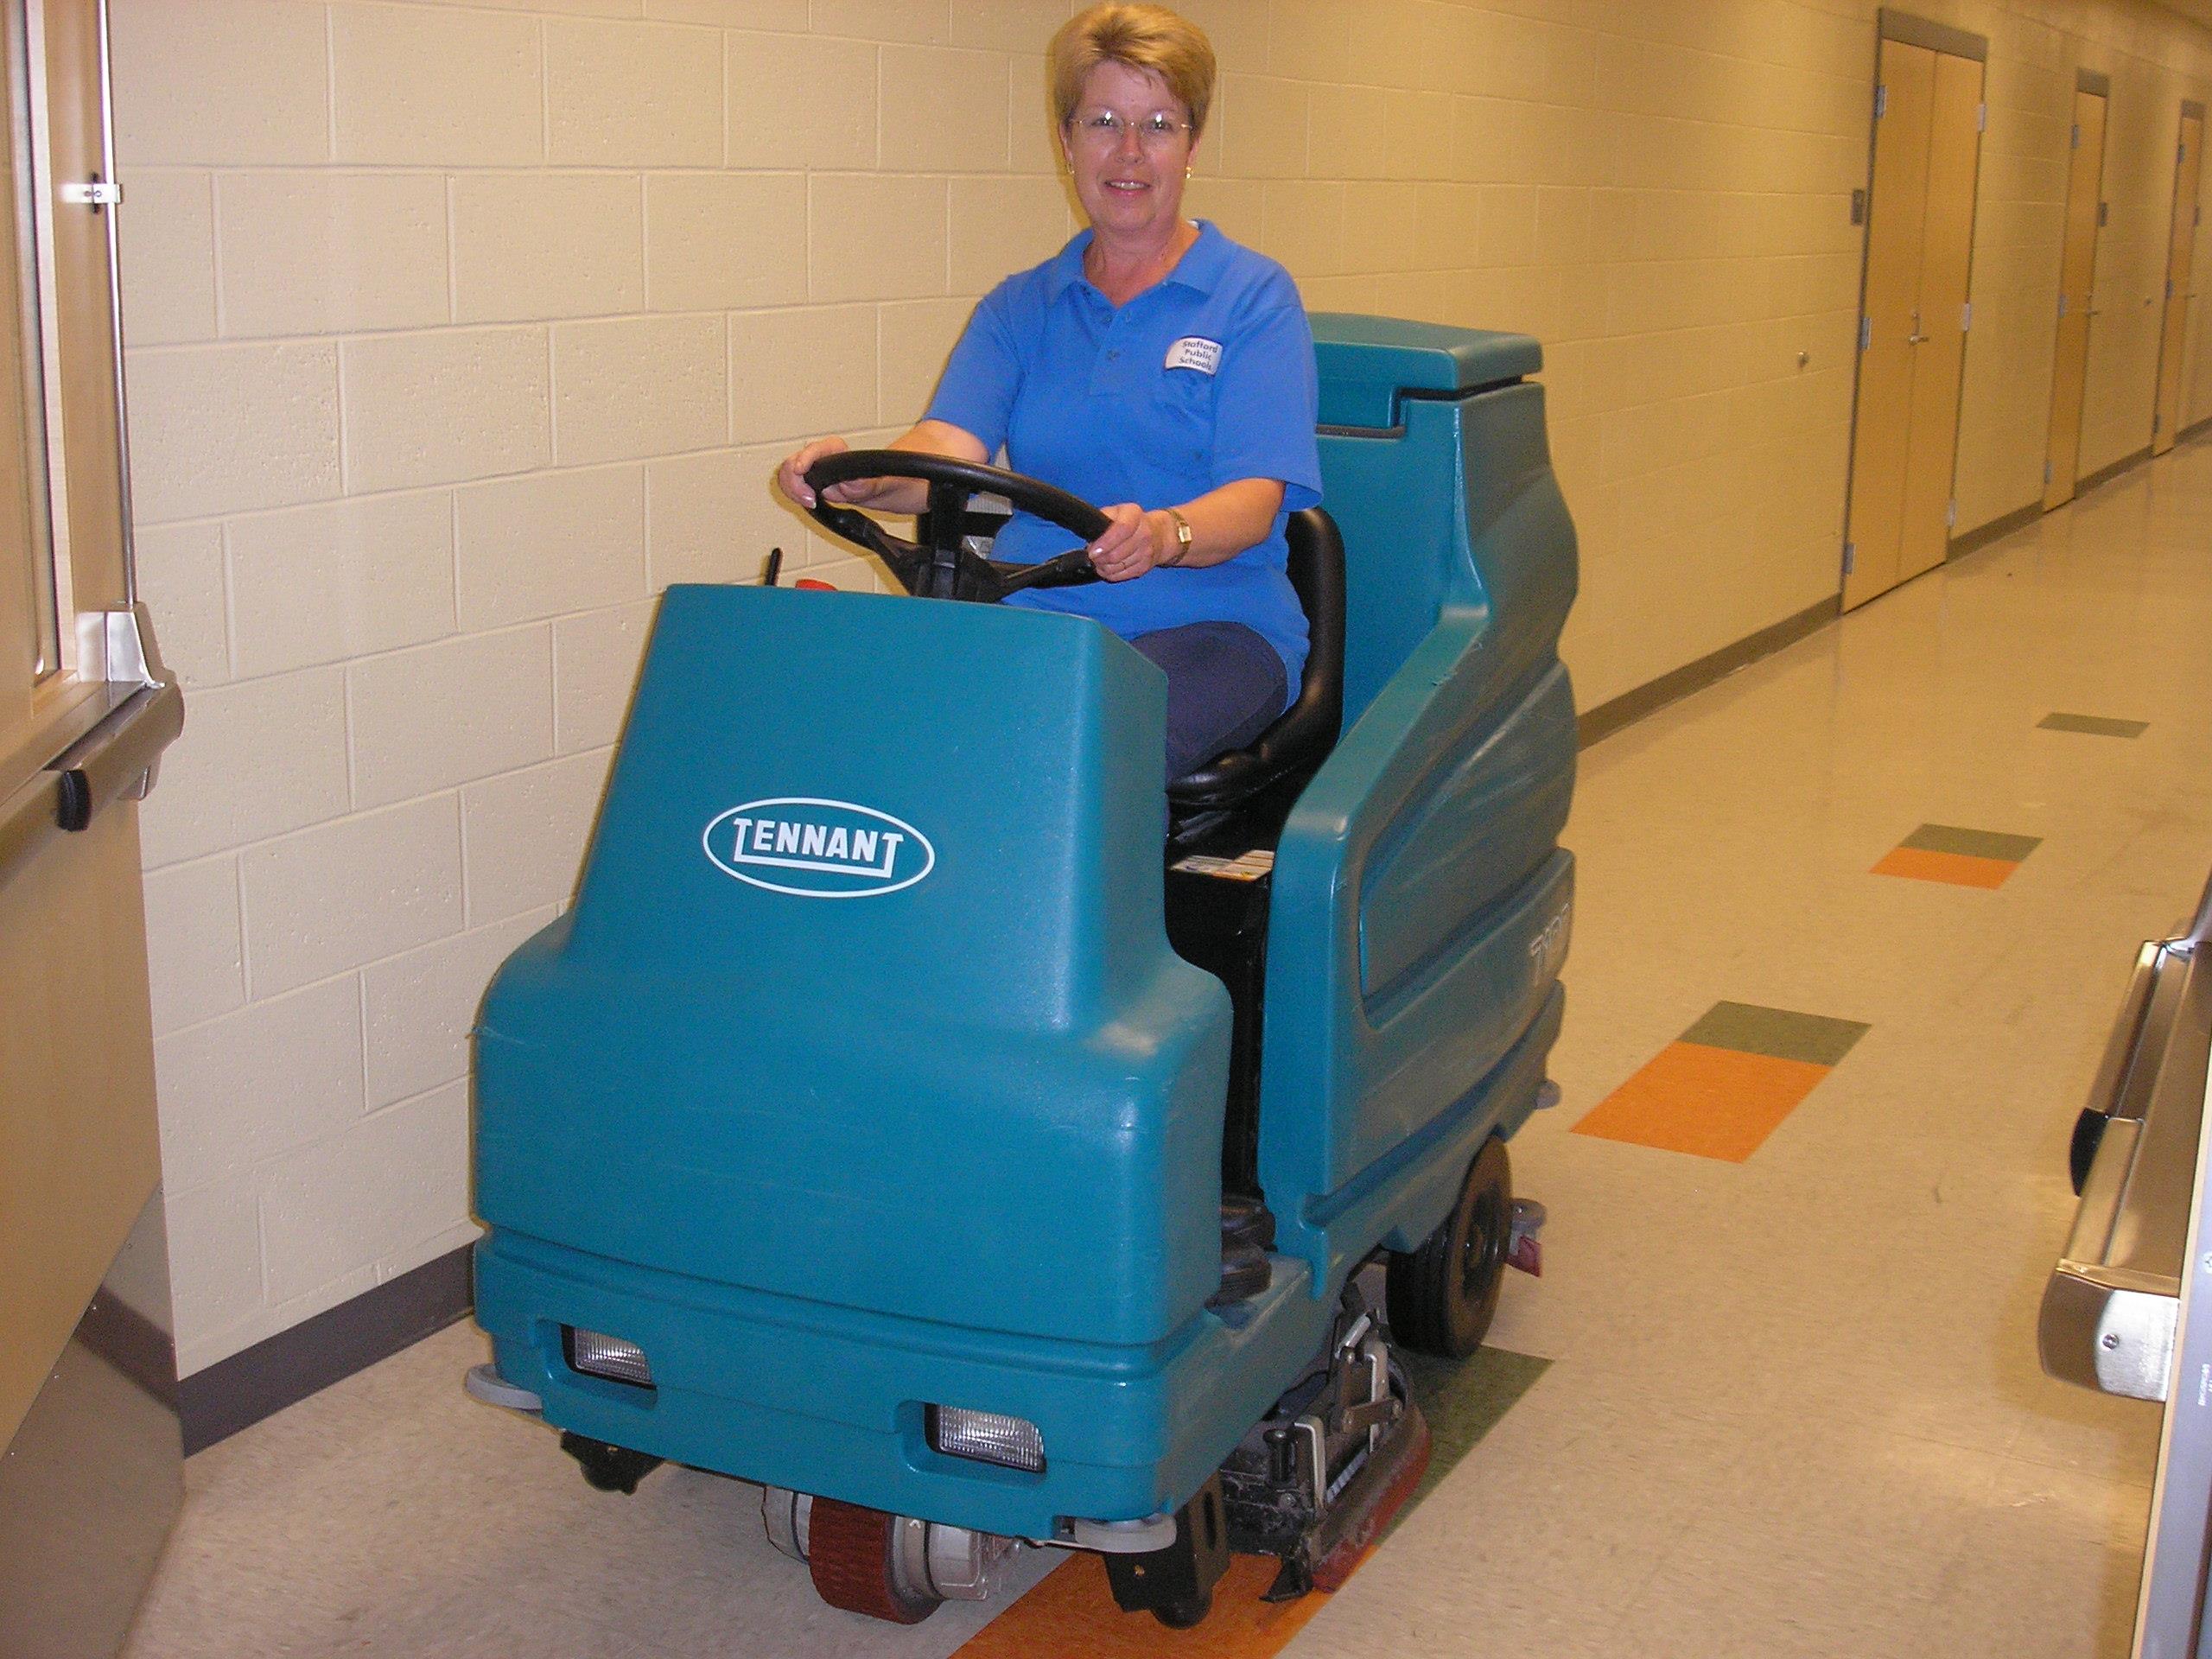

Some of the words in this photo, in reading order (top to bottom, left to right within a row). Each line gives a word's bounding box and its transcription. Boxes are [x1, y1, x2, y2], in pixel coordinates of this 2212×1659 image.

[1182, 340, 1219, 353] Stafford
[1185, 348, 1212, 360] Public
[1179, 356, 1212, 370] Schools
[734, 817, 904, 879] TENNANT
